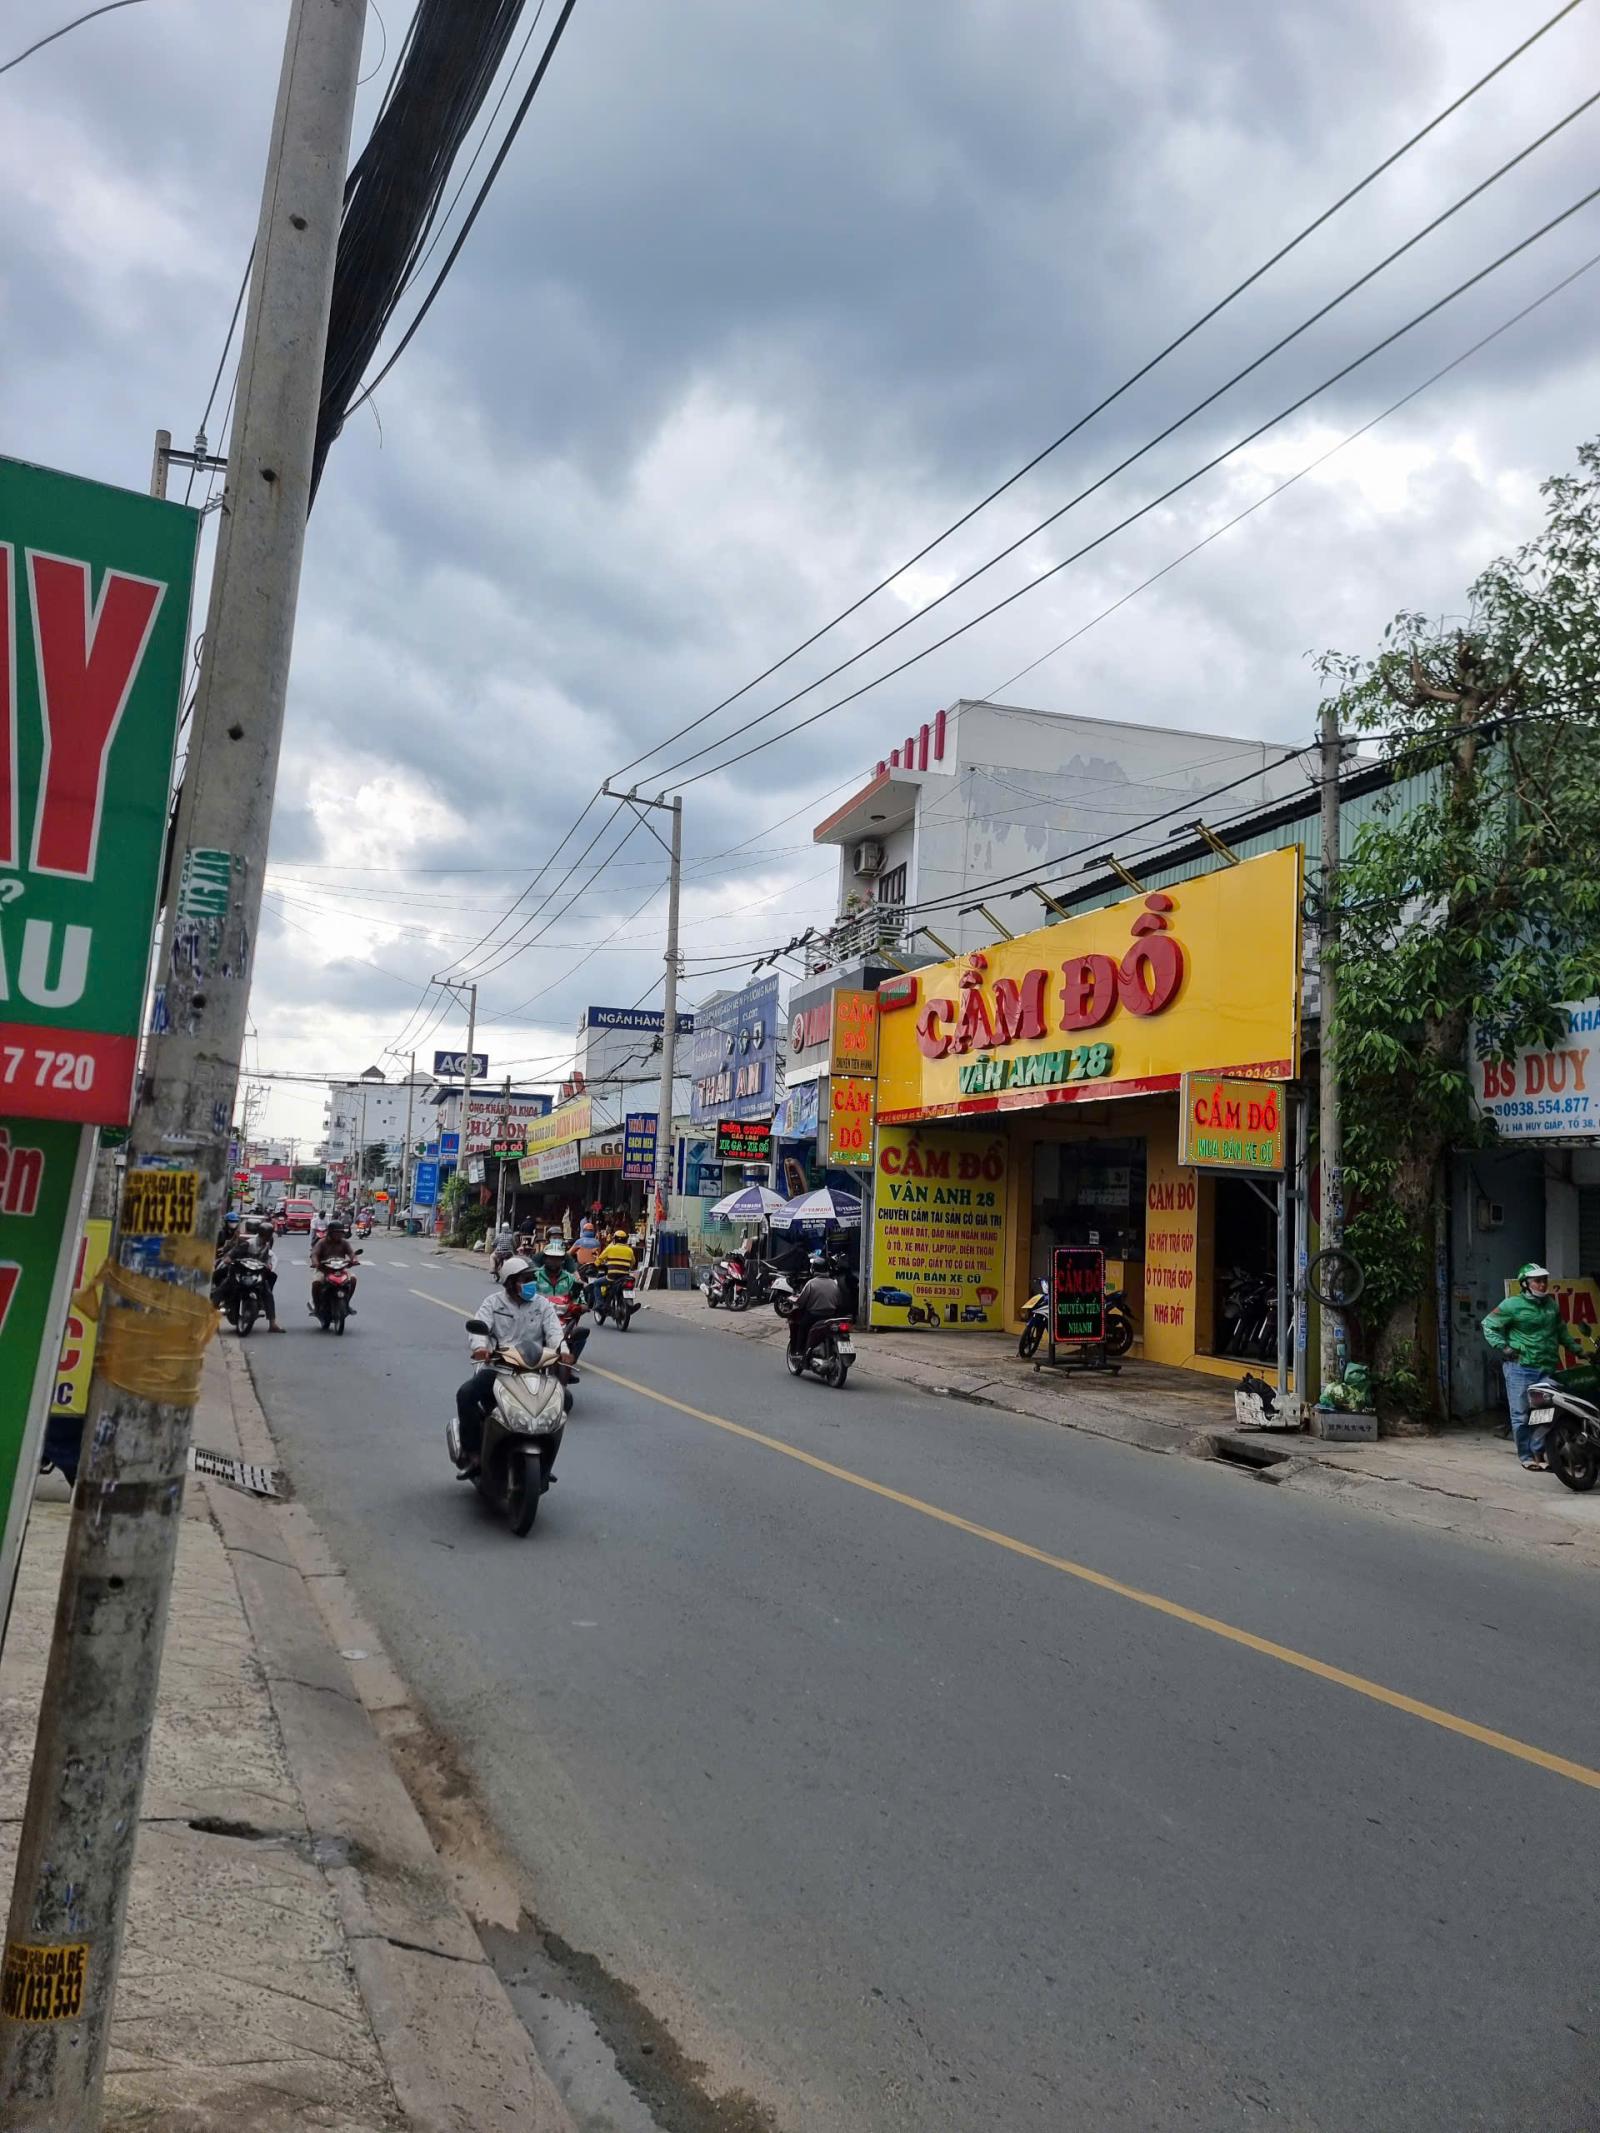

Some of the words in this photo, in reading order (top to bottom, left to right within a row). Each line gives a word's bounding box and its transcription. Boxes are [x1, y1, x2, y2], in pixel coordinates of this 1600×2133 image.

[0, 541, 168, 881] Y
[916, 954, 1048, 1059] CẦM
[1059, 893, 1184, 1031] ĐỒ
[598, 1012, 632, 1025] NGÂN
[34, 1050, 96, 1091] 720
[736, 1063, 761, 1098] AN
[959, 1054, 1010, 1094] VÂN
[1008, 1049, 1072, 1087] ANH
[1068, 1042, 1114, 1081] 28
[1483, 1058, 1516, 1098] BS
[1524, 1048, 1590, 1095] DUY
[1503, 1097, 1589, 1117] 0938.554.877
[880, 1131, 950, 1178] CẦM
[958, 1139, 1004, 1182] ĐỒ
[1197, 1138, 1218, 1158] MUA
[1223, 1137, 1242, 1159] BÁN
[1245, 1142, 1257, 1161] XE
[1261, 1140, 1273, 1162] CŨ
[889, 1180, 928, 1203] VÂN
[933, 1187, 972, 1206] ANH
[975, 1192, 996, 1208] 28
[1149, 1168, 1174, 1210] CẦM
[1177, 1169, 1196, 1211] ĐỒ
[888, 1257, 897, 1266] XE
[905, 1242, 913, 1252] XE
[895, 1271, 920, 1281] MUA
[923, 1270, 947, 1282] BÁN
[950, 1273, 964, 1283] XE
[967, 1272, 982, 1284] CŨ
[1068, 1321, 1093, 1334] NHANH
